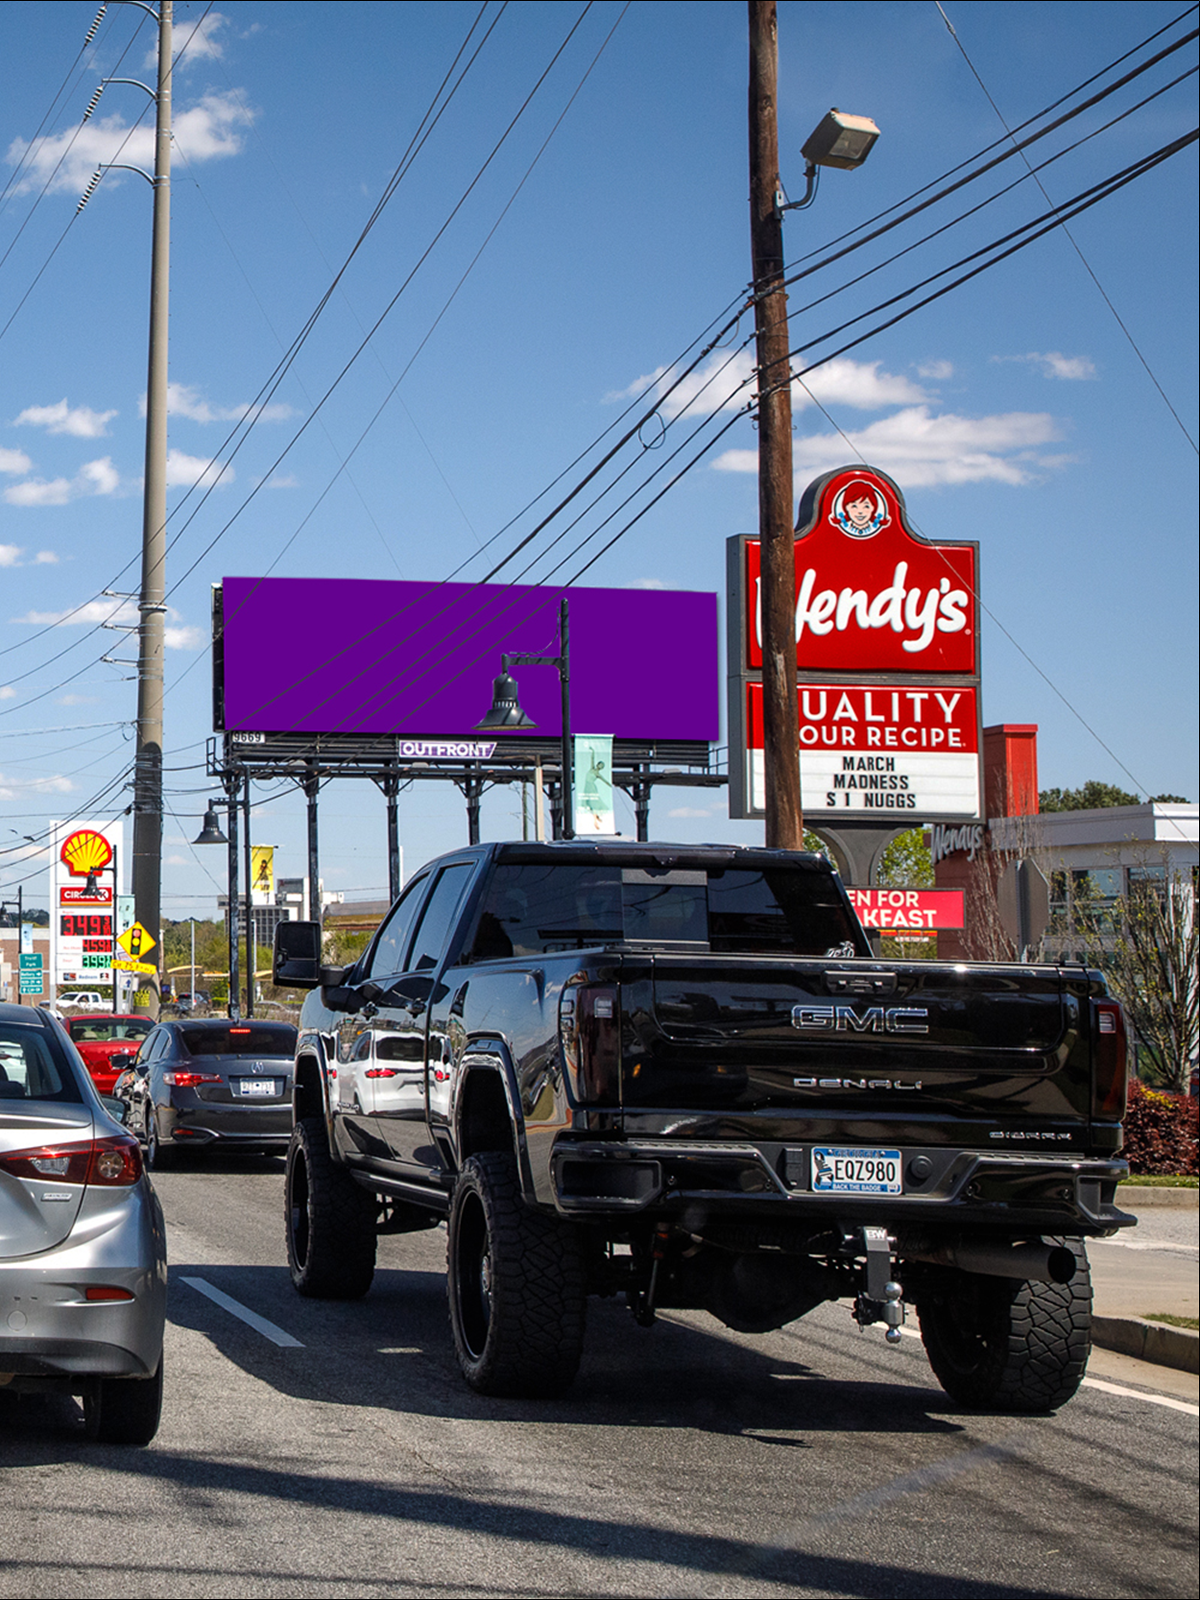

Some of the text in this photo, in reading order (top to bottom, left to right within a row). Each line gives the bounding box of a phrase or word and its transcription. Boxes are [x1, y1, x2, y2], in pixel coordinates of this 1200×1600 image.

[755, 561, 969, 653] endy's
[802, 691, 961, 723] UALITY
[233, 733, 263, 743] 9669
[402, 742, 490, 757] OUTFRONT
[843, 756, 895, 771] MARCH
[834, 774, 909, 789] MADNESS
[865, 793, 916, 808] NUGGS
[848, 890, 919, 907] EN FOR
[791, 1005, 929, 1034] GMC
[793, 1077, 922, 1090] DENALI
[835, 1160, 896, 1182] EQZ980
[833, 1183, 848, 1191] BACK
